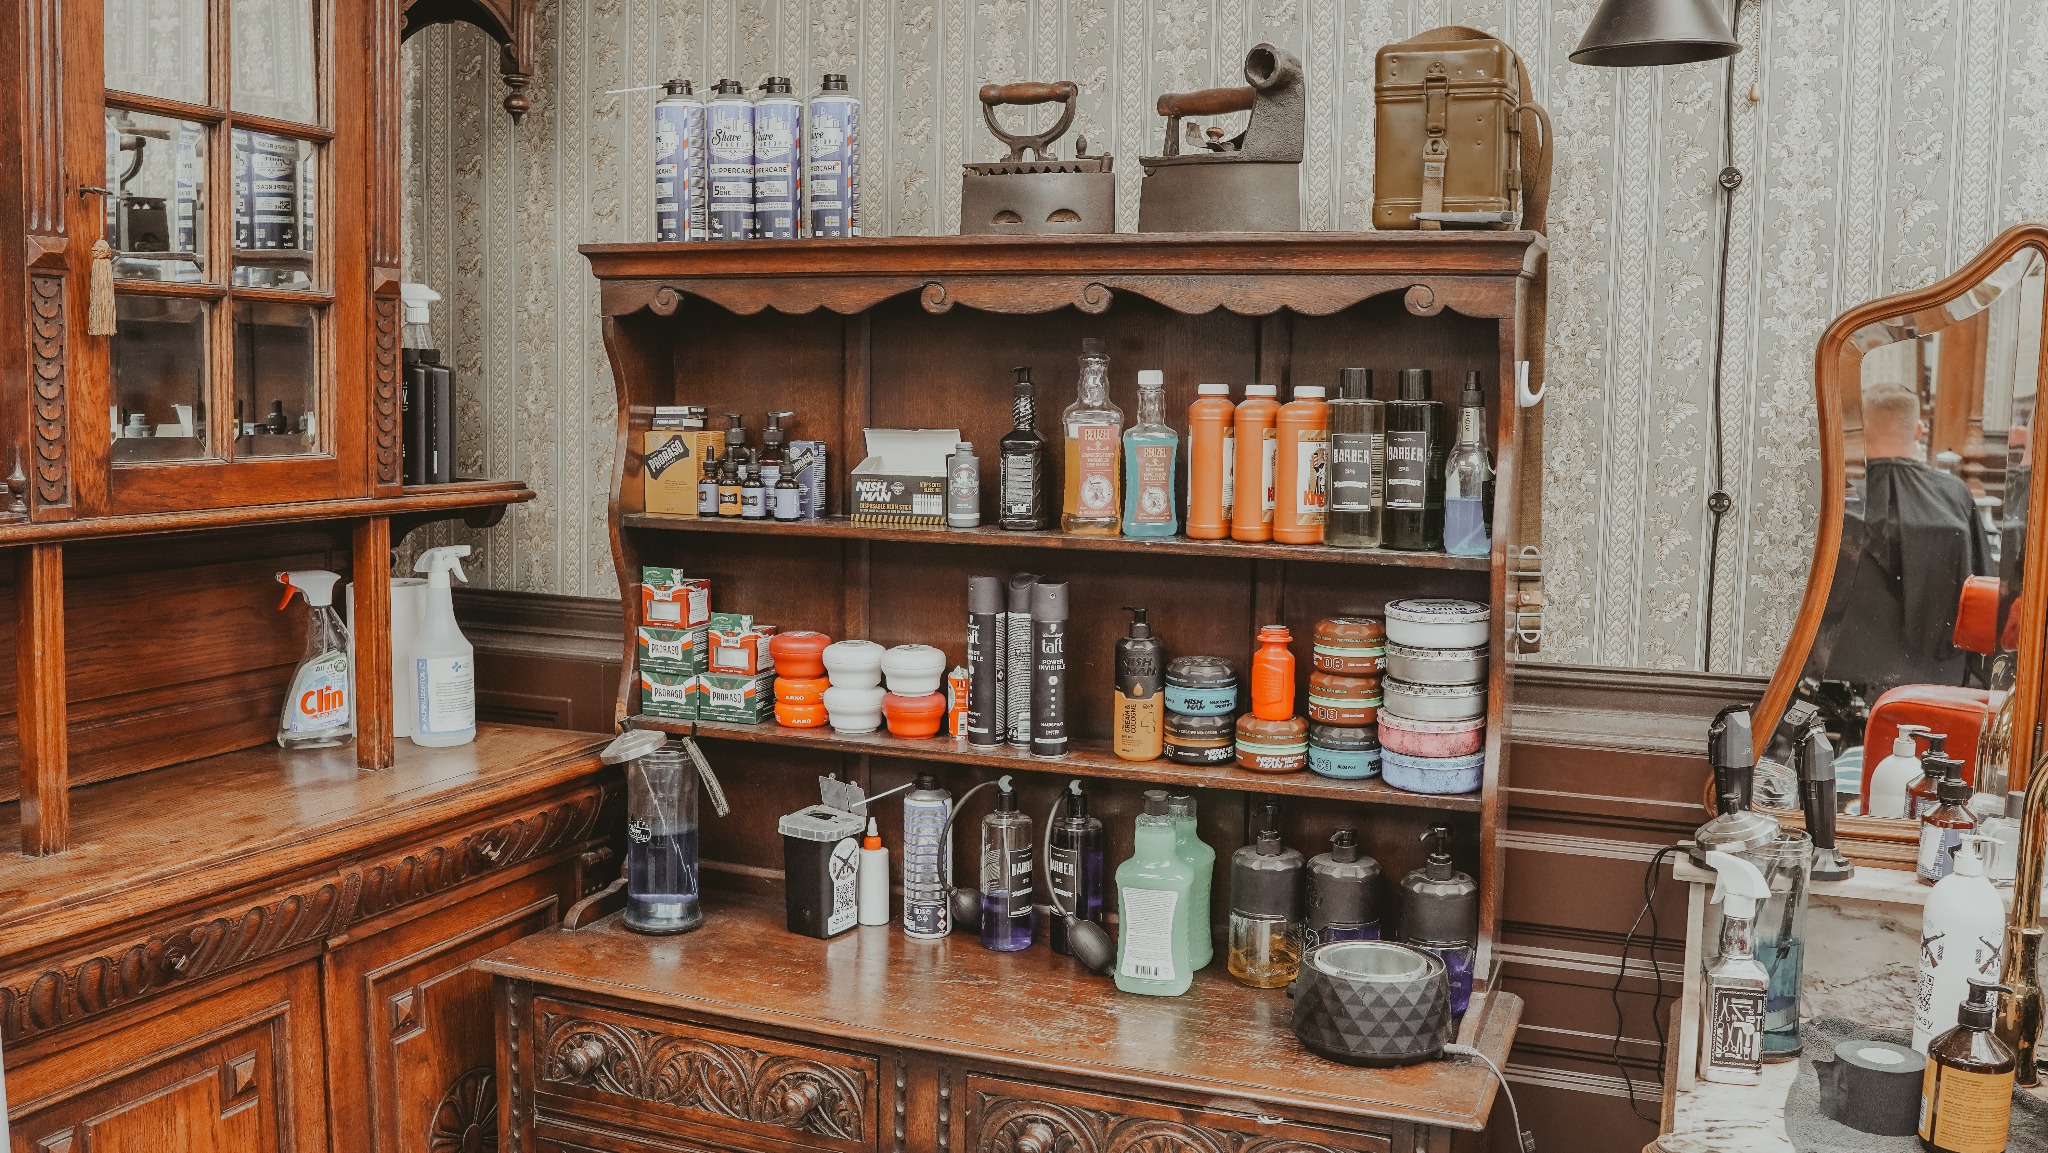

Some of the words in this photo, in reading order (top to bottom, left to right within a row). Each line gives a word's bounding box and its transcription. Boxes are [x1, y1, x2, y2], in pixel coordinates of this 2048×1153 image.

[1085, 429, 1111, 441] REUZEL
[648, 440, 684, 473] PRORASO
[1144, 448, 1167, 457] REUZEL
[1333, 448, 1369, 464] BARBER
[1388, 446, 1424, 462] BARBER
[860, 492, 891, 502] MAN
[651, 643, 679, 655] PRORASO
[1041, 638, 1064, 654] taft
[654, 688, 683, 699] PRORASO
[712, 692, 742, 703] PRORASO
[301, 686, 343, 714] Clin
